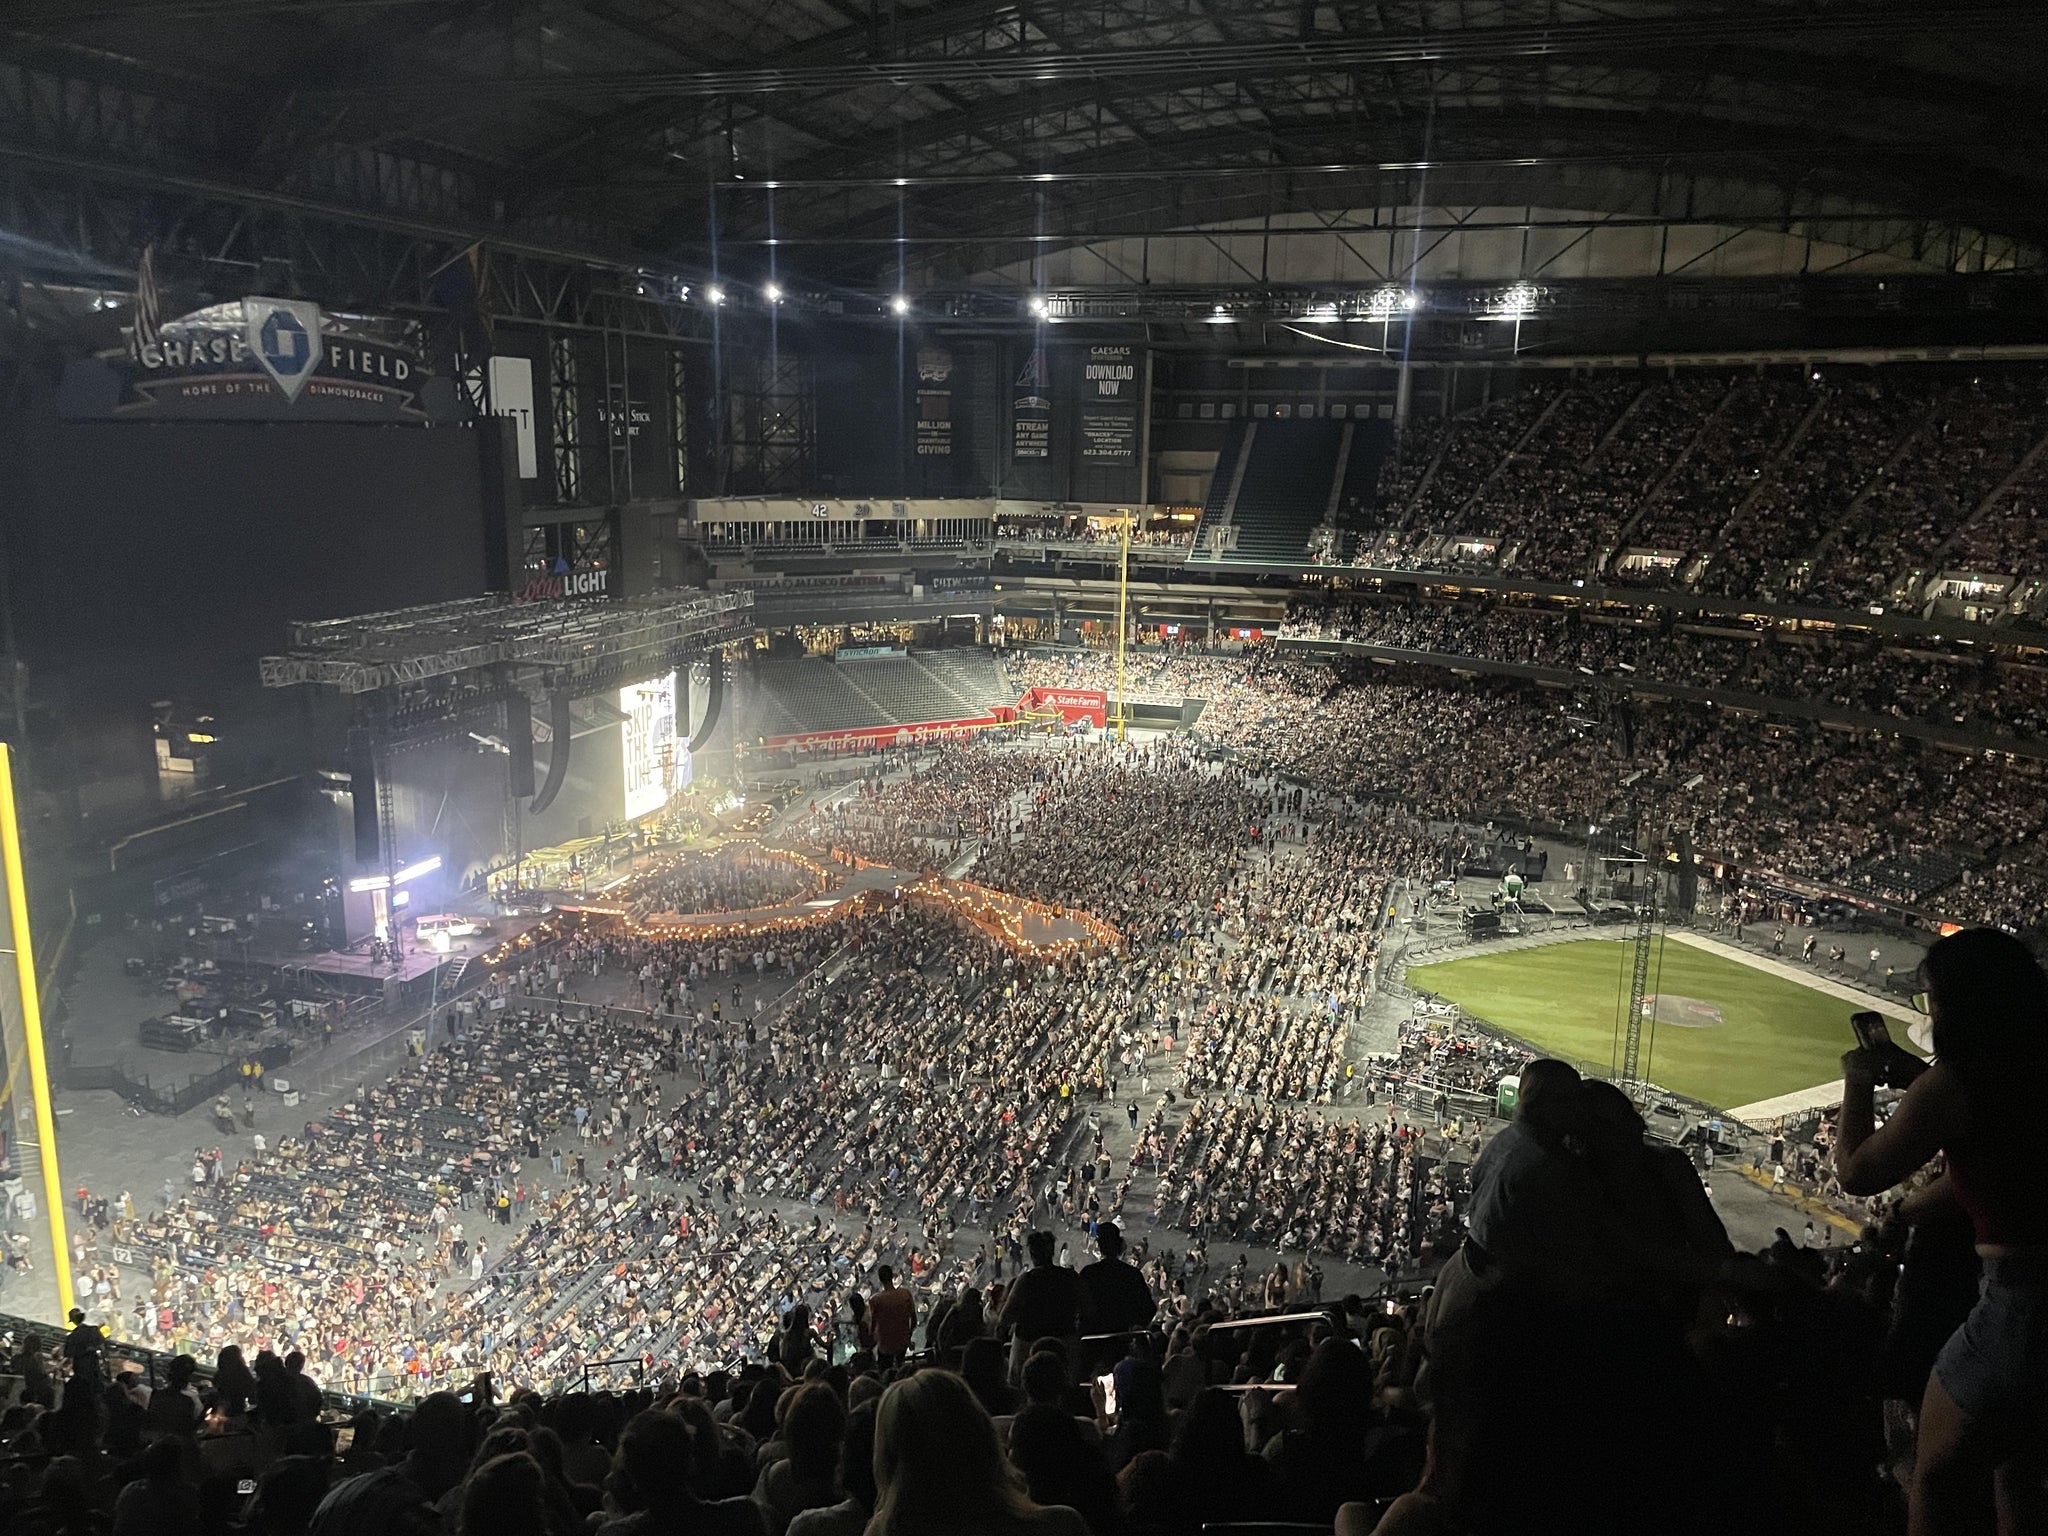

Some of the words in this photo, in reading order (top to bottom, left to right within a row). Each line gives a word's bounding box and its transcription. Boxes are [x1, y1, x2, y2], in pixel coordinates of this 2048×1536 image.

[1091, 347, 1130, 355] CAESARS
[141, 338, 248, 369] CHASE
[331, 345, 409, 380] FIELD
[1086, 365, 1133, 380] DOWNLOAD
[182, 384, 217, 396] HOME
[226, 383, 241, 393] OF
[250, 383, 270, 393] THE
[310, 384, 384, 402] DIAMONDBACKS
[1099, 380, 1119, 395] NOW
[917, 421, 951, 429] MILLION
[1016, 422, 1049, 431] STREAM
[917, 445, 951, 454] GIVING
[812, 504, 828, 517] 42
[855, 504, 871, 517] 20
[892, 503, 906, 517] 51
[564, 570, 607, 597] LIGHT
[794, 577, 838, 588] JALISCO
[933, 576, 985, 588] CUTWATER
[626, 704, 652, 737] SKIP
[627, 733, 649, 763] THE
[628, 761, 652, 793] LINE
[115, 1250, 129, 1262] F2
